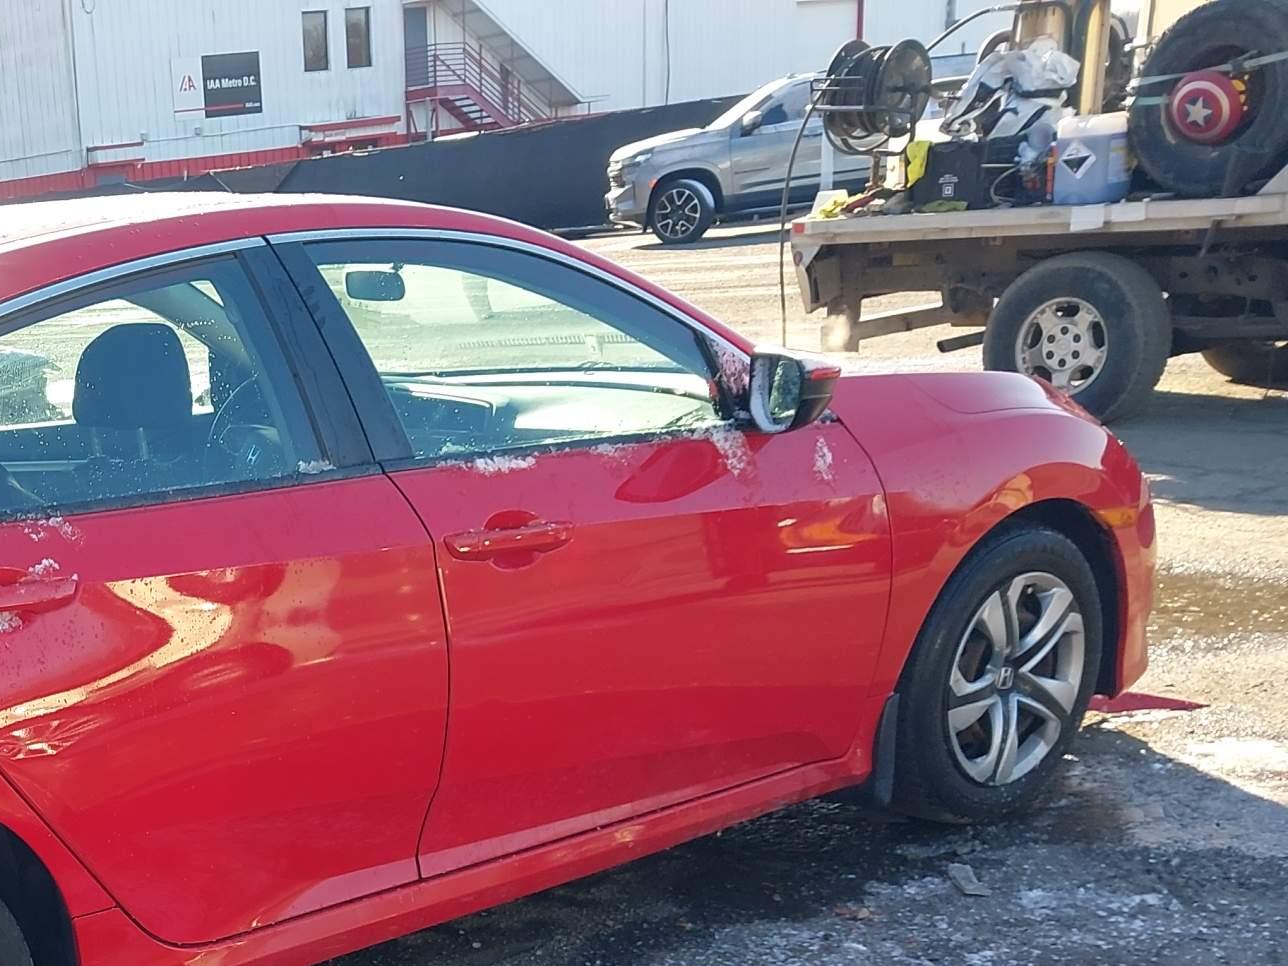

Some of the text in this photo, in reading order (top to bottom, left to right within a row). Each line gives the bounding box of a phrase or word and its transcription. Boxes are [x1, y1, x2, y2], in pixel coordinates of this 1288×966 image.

[207, 76, 256, 89] IAA Metro D.C.
